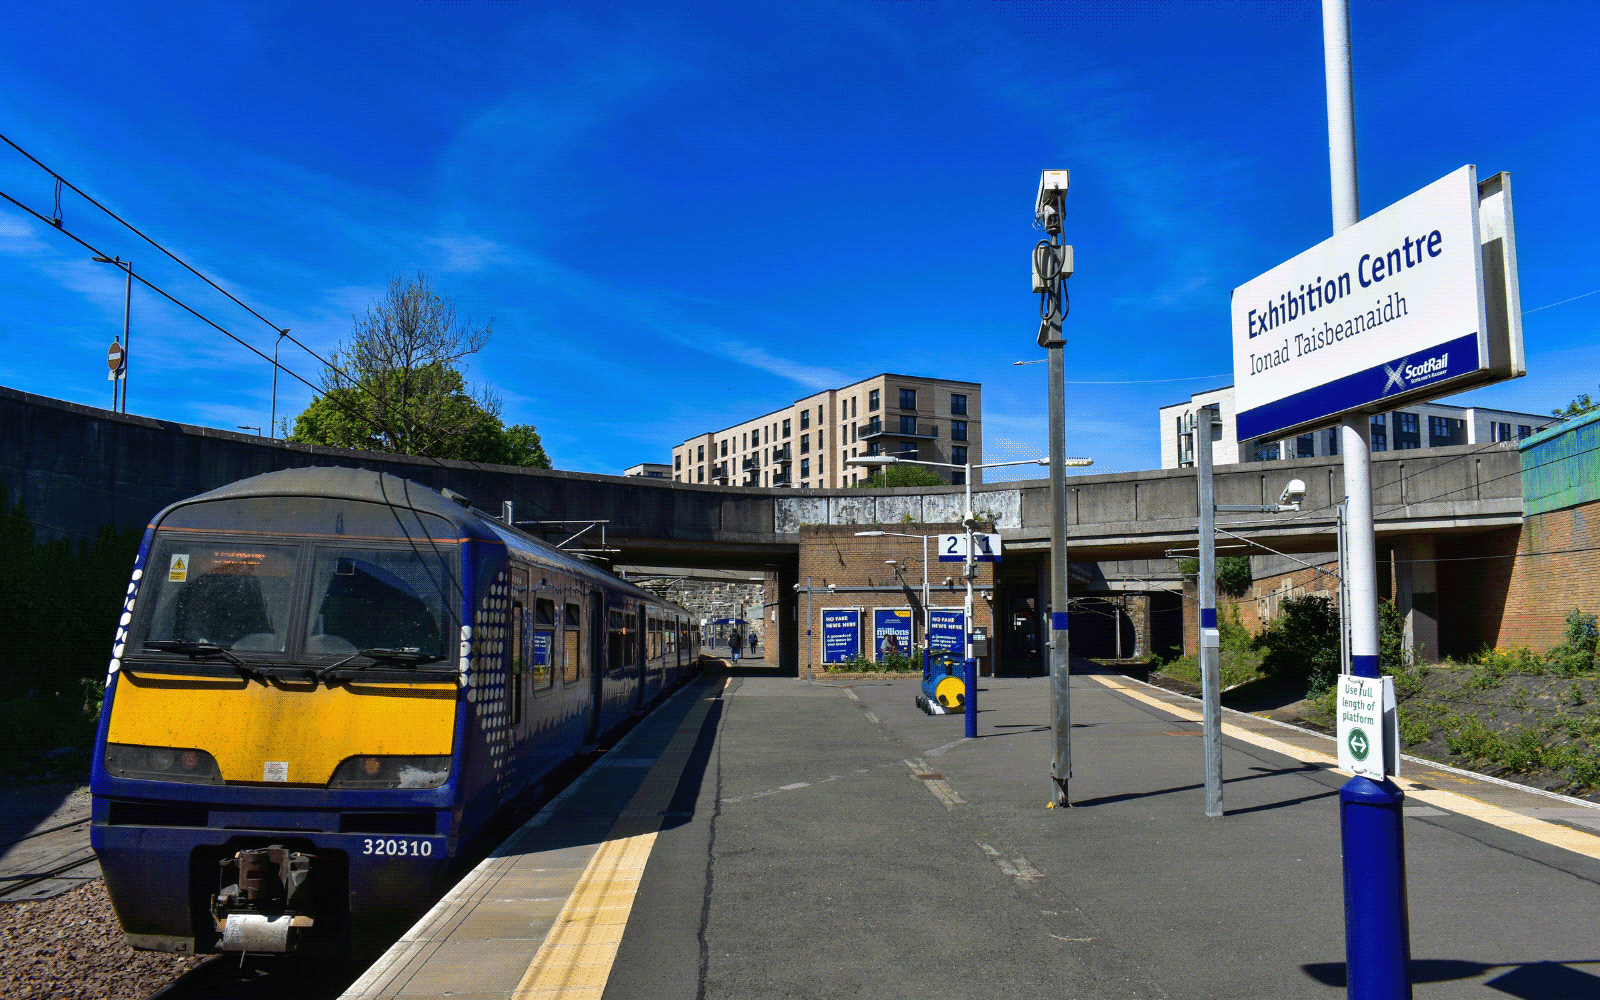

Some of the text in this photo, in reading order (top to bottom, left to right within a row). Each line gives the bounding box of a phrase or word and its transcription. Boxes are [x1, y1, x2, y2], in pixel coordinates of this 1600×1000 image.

[1248, 229, 1443, 339] Exhibition Centre
[1250, 292, 1408, 376] Ionad Taisbeanaidh
[1405, 352, 1448, 380] ScotRail
[947, 535, 958, 554] 2
[981, 535, 992, 553] 1
[876, 627, 910, 636] millions
[1345, 683, 1373, 698] Use full
[1342, 696, 1376, 711] length of
[1342, 710, 1374, 726] platform
[362, 838, 432, 857] 320310
